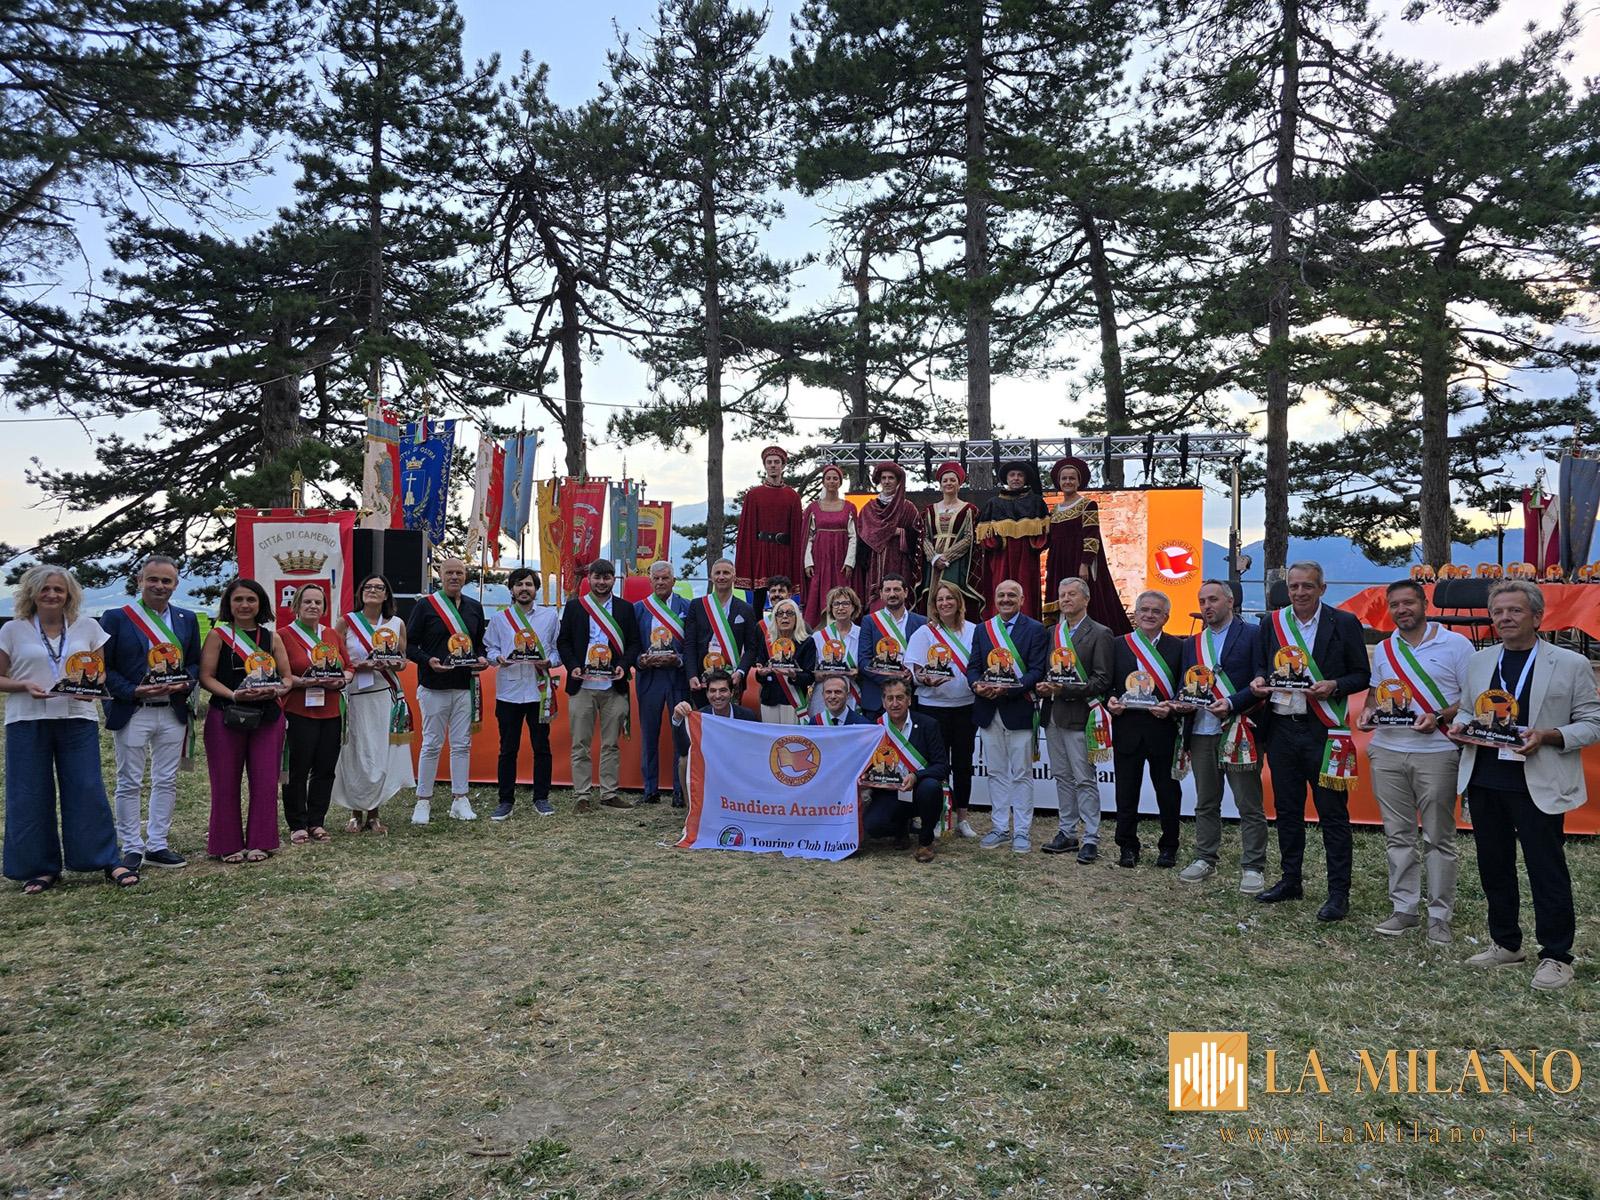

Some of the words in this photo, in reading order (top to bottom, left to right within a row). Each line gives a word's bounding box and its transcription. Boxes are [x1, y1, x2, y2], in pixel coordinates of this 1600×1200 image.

[286, 530, 295, 540] DI
[720, 796, 786, 816] Bandiera
[797, 839, 822, 851] Club
